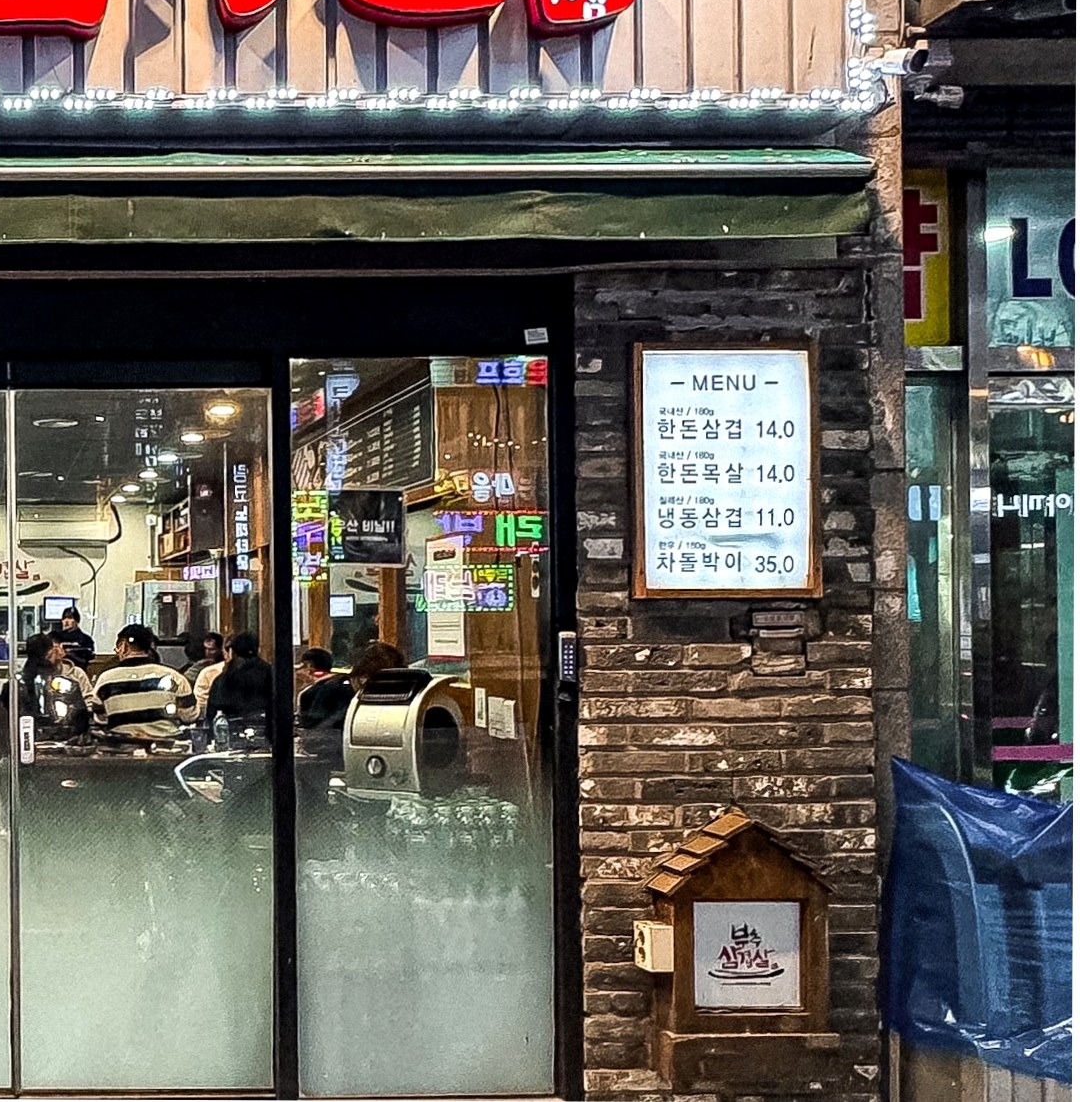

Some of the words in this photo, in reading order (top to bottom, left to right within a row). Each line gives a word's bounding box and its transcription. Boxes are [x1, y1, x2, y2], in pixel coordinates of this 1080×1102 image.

[692, 375, 756, 391] MENU
[657, 419, 742, 440] 한돈삼겹
[756, 420, 795, 439] 14.0
[657, 463, 743, 484] 한돈목살
[756, 464, 795, 483] 14.0
[658, 507, 742, 528] 냉동삼겹
[756, 508, 795, 527] 11.0
[656, 551, 742, 573] 차돌박이
[755, 555, 795, 574] 35.0
[731, 920, 762, 949] 부추
[718, 945, 776, 970] 삼겹살
